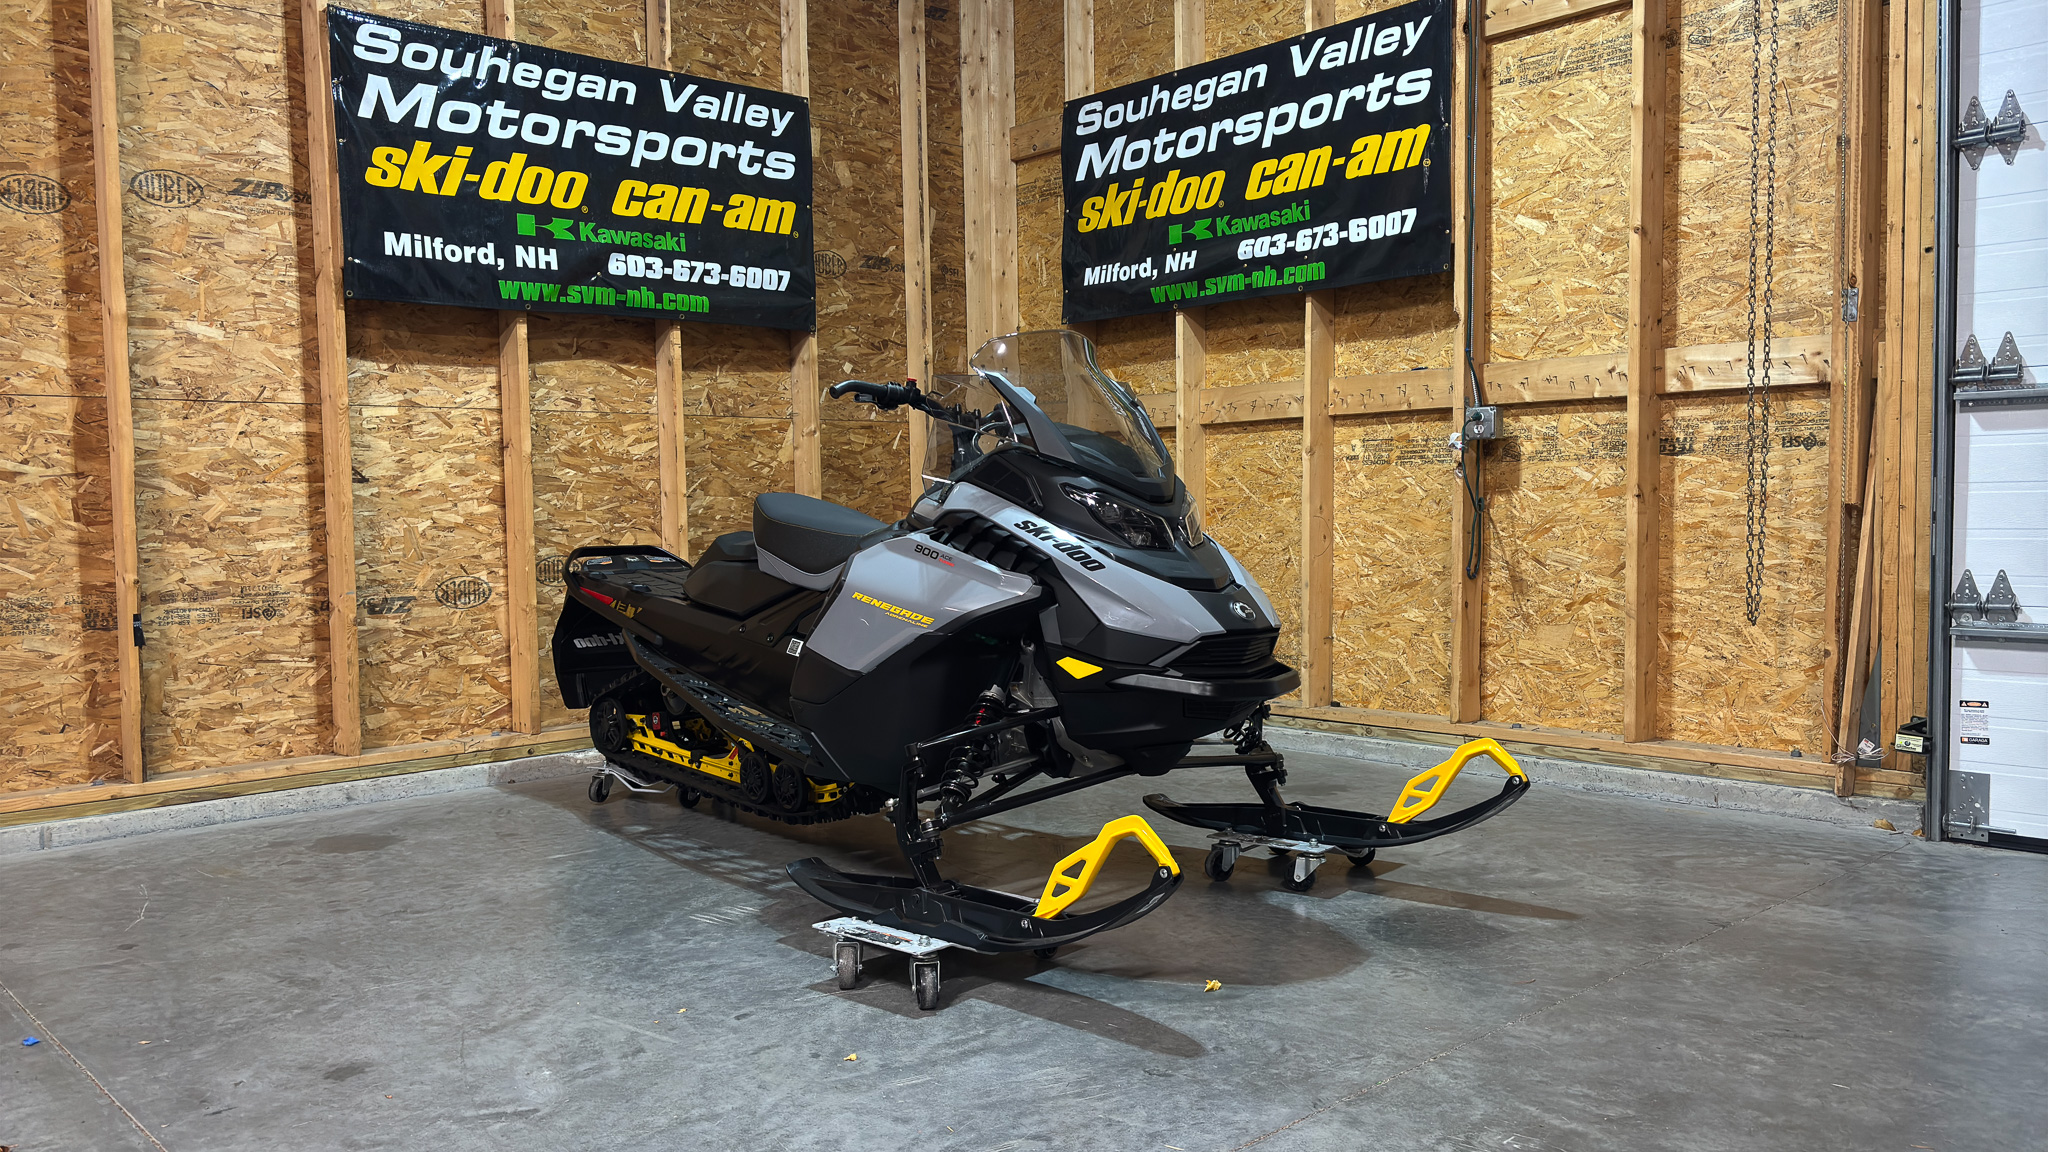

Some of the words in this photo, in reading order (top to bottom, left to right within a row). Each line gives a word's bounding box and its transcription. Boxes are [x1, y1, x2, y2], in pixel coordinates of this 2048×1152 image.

[353, 23, 637, 103] Souhegan
[659, 78, 795, 137] Valley
[1076, 62, 1268, 136] Souhegan
[1290, 15, 1433, 78] Valley
[357, 73, 796, 180] Motorsports
[1075, 67, 1433, 182] Motorsports
[137, 171, 200, 205] HUBER
[364, 140, 588, 211] ski-doo
[611, 179, 797, 236] can-am
[1077, 168, 1226, 234] ski-doo
[1245, 124, 1432, 201] can-am
[579, 221, 687, 252] Kawasaki
[1217, 200, 1311, 237] Kawasaki
[1237, 207, 1418, 260] 603-673-6007
[384, 231, 505, 271] Milford,
[516, 247, 559, 271] NH
[814, 253, 844, 276] HUBER
[1084, 257, 1158, 287] Milford,
[1165, 250, 1197, 275] NH
[607, 252, 791, 292] 603-673-6007
[1151, 260, 1326, 304] www.svm-nh.com
[499, 279, 710, 313] www.svm-nh.com
[914, 544, 940, 560] 900
[940, 554, 953, 562] ACE
[1013, 519, 1107, 572] ski-doo
[851, 591, 936, 625] RENEGADE
[884, 611, 929, 628] ADRENALINE
